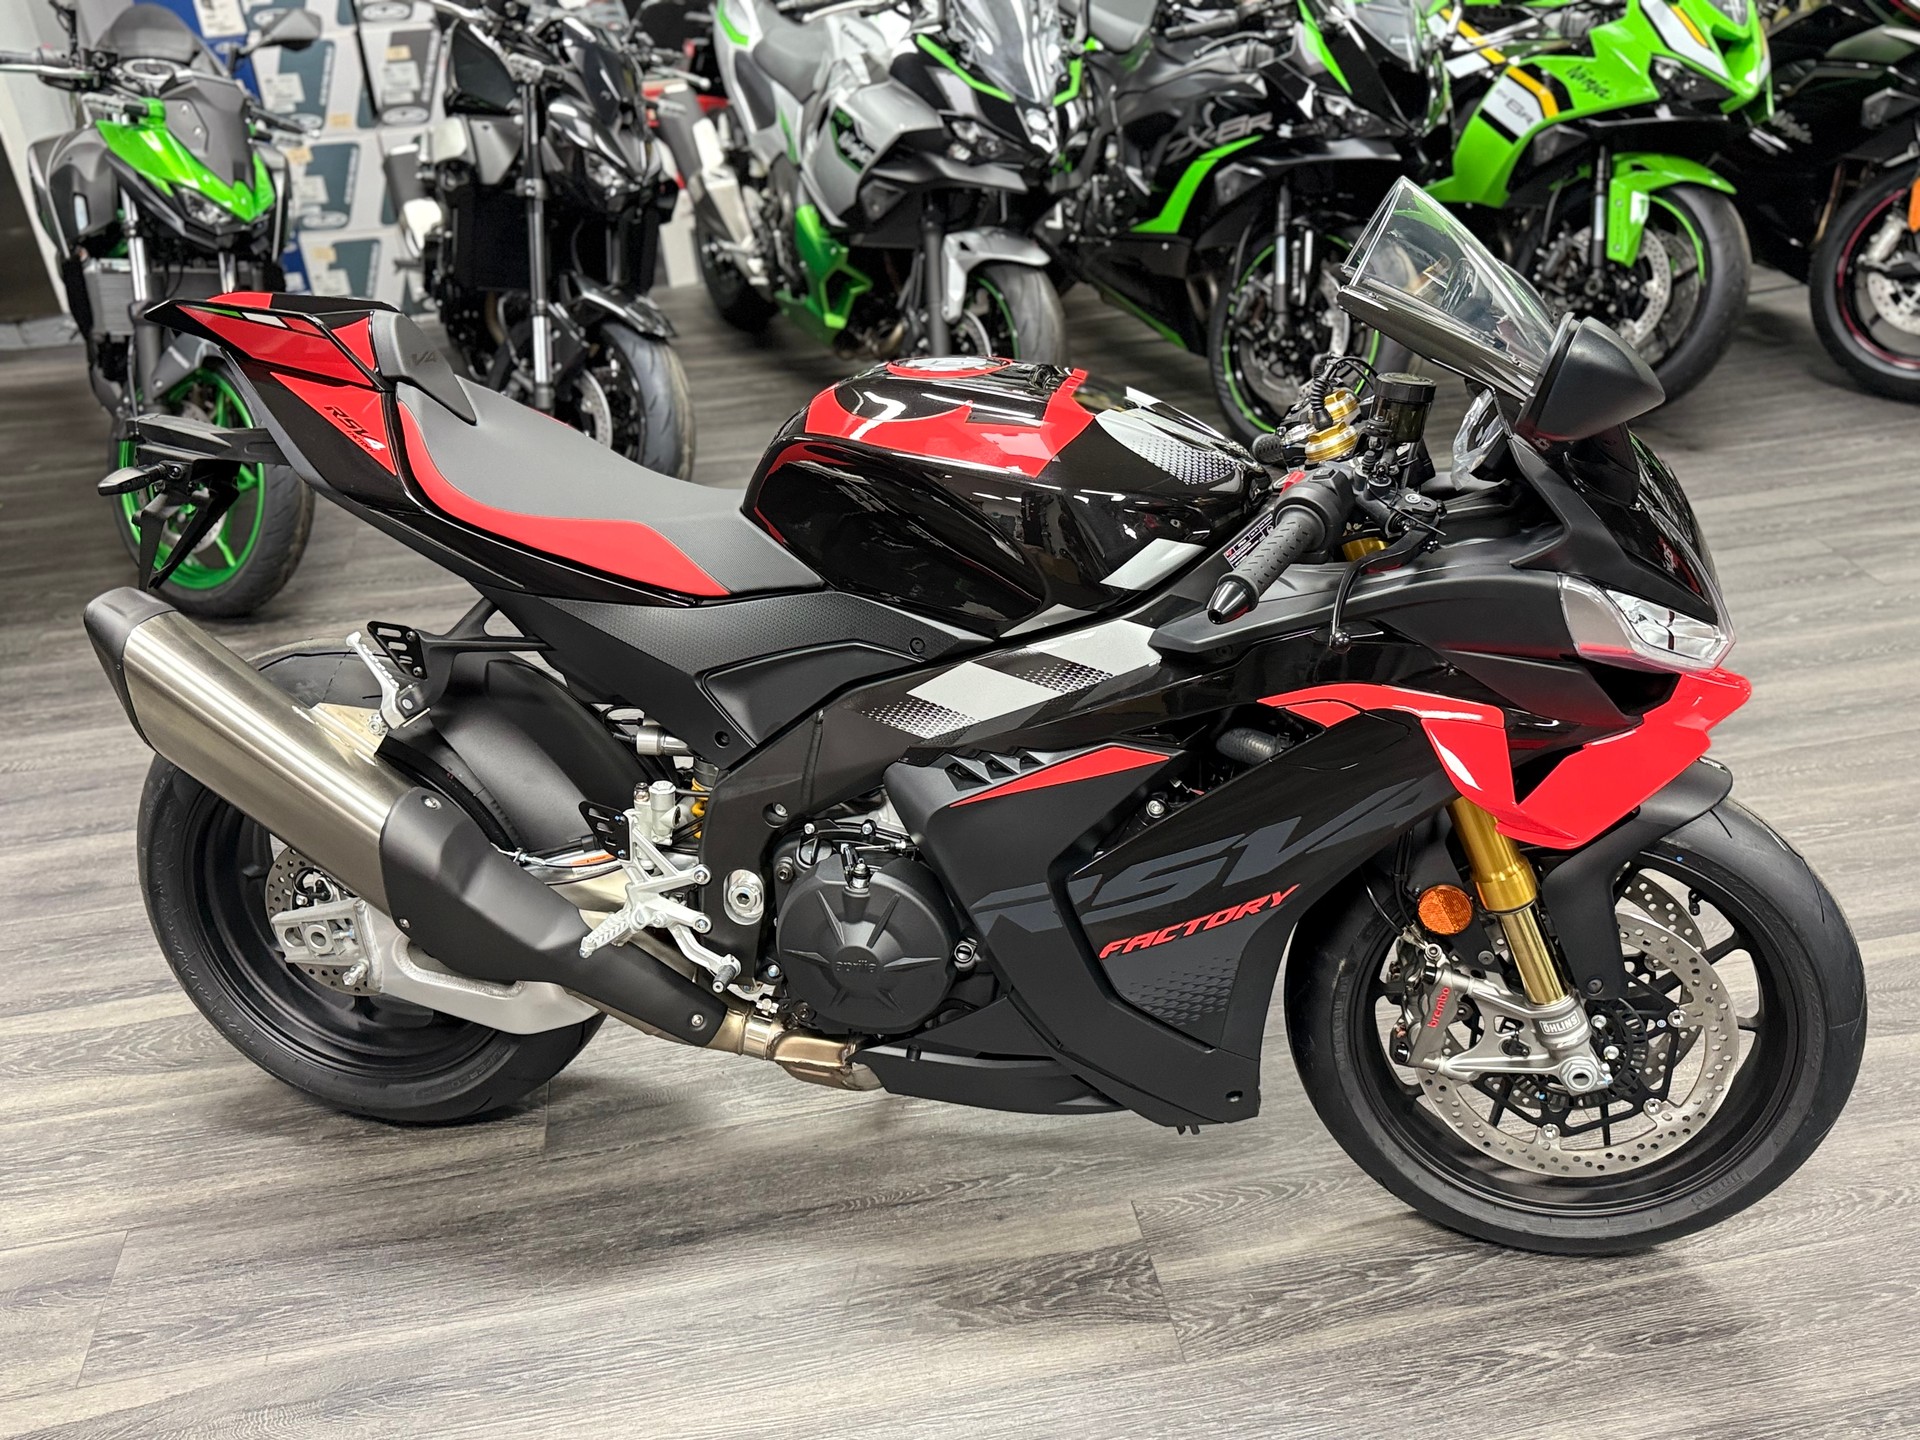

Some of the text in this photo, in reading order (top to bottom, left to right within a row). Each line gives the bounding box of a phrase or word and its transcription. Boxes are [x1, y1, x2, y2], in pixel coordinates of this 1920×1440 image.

[411, 350, 437, 366] V4
[323, 404, 386, 451] RSV4
[1099, 883, 1301, 959] FACTORY
[1427, 985, 1451, 1029] brembo
[1541, 1013, 1580, 1033] ÖHLINS
